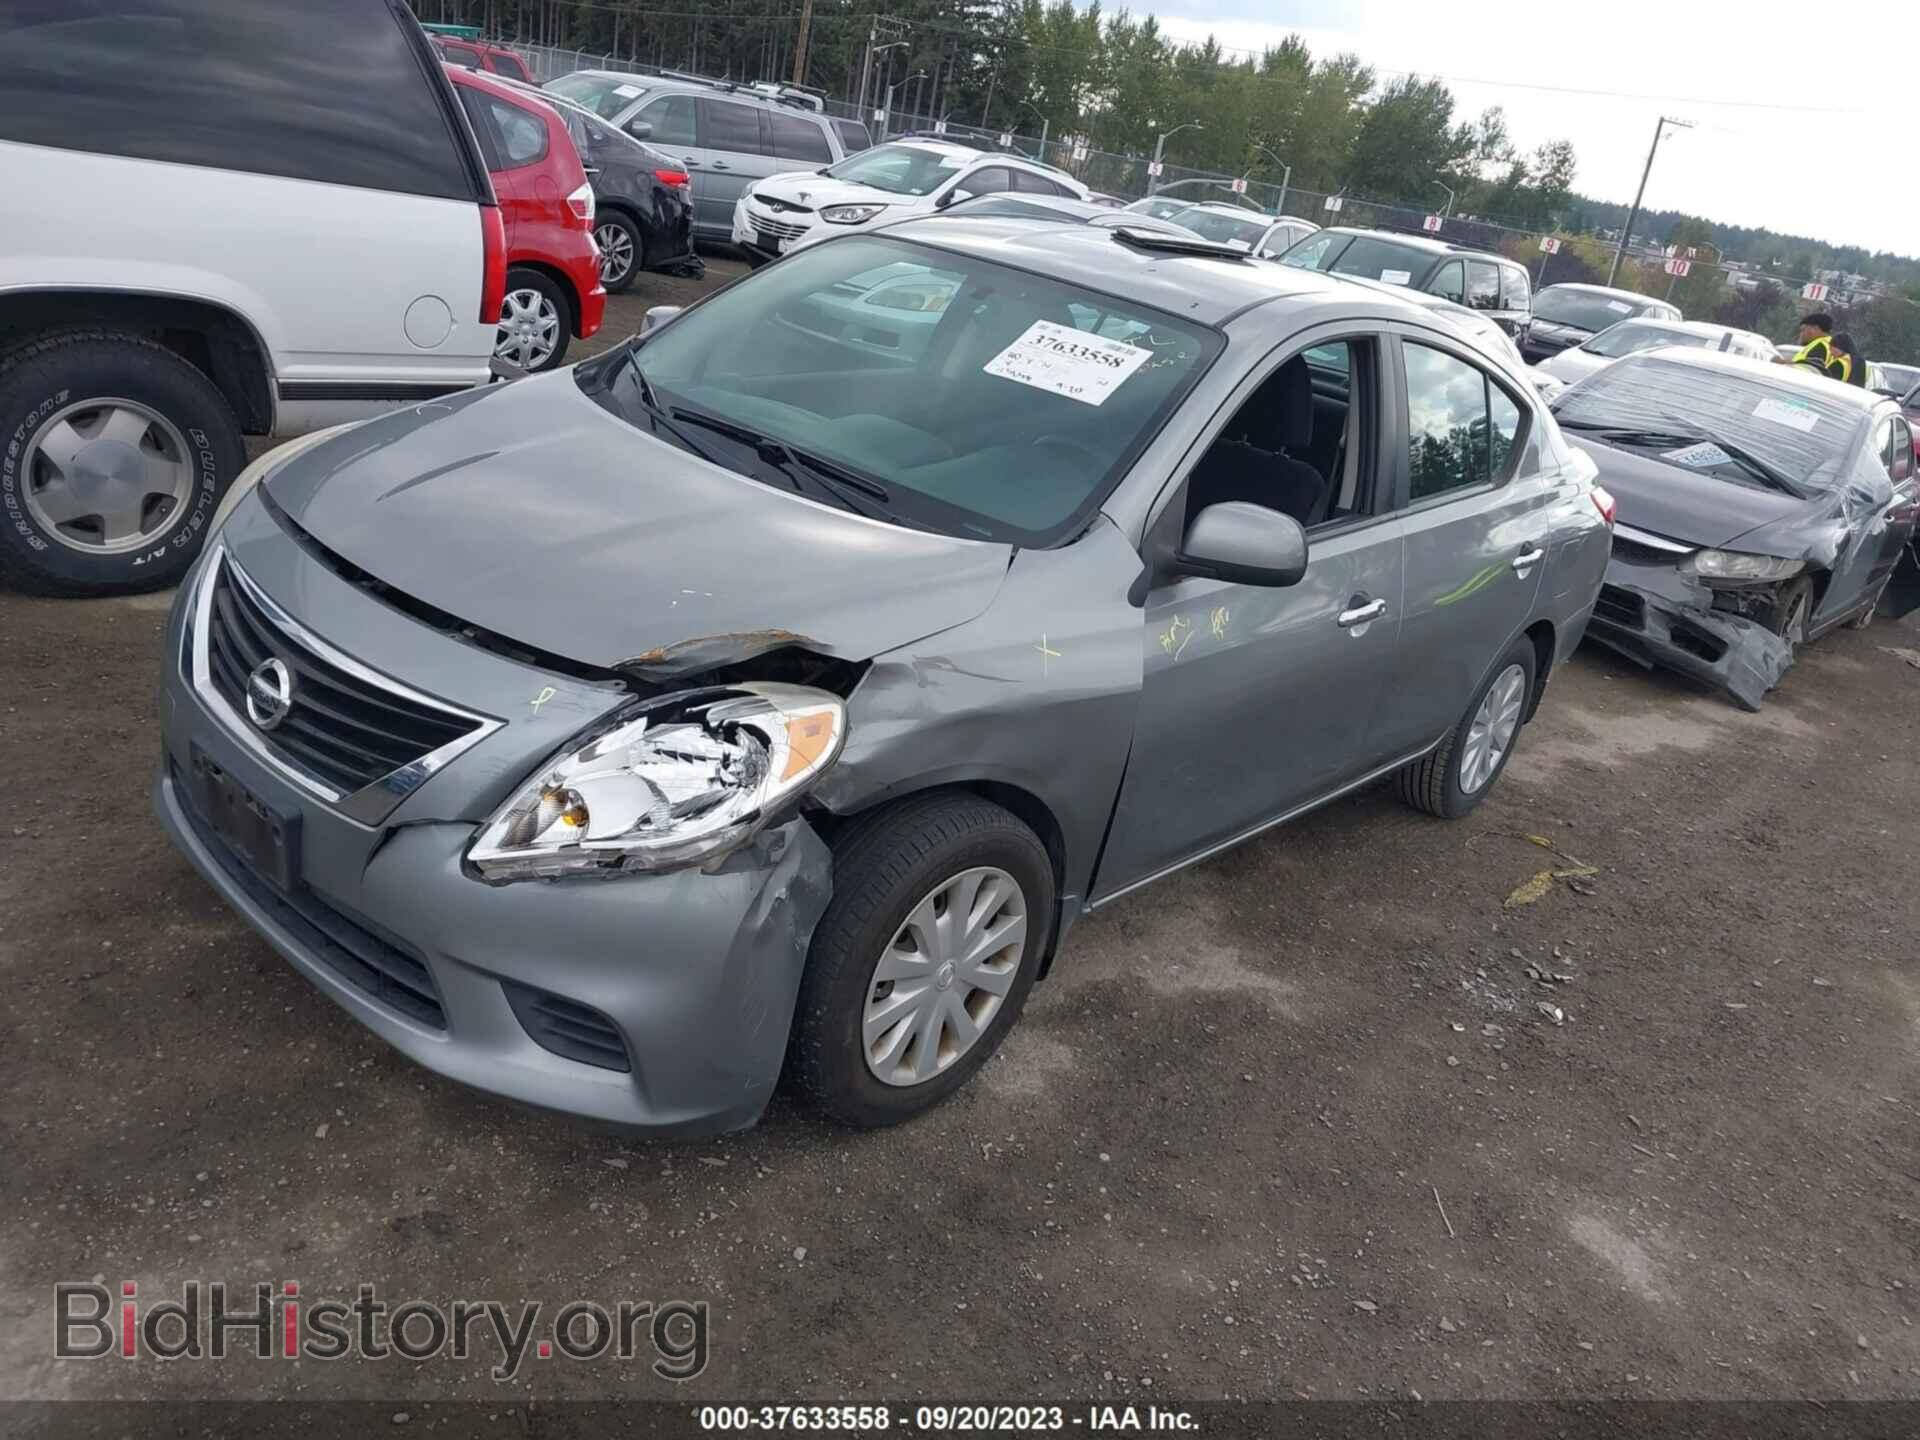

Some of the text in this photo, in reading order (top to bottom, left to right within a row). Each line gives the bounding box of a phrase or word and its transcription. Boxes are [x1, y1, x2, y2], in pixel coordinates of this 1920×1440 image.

[1671, 259, 1687, 274] 10
[1028, 334, 1125, 368] 37633558
[2, 389, 70, 551] BRIDGESTONE
[132, 428, 216, 566] DUELER A/T
